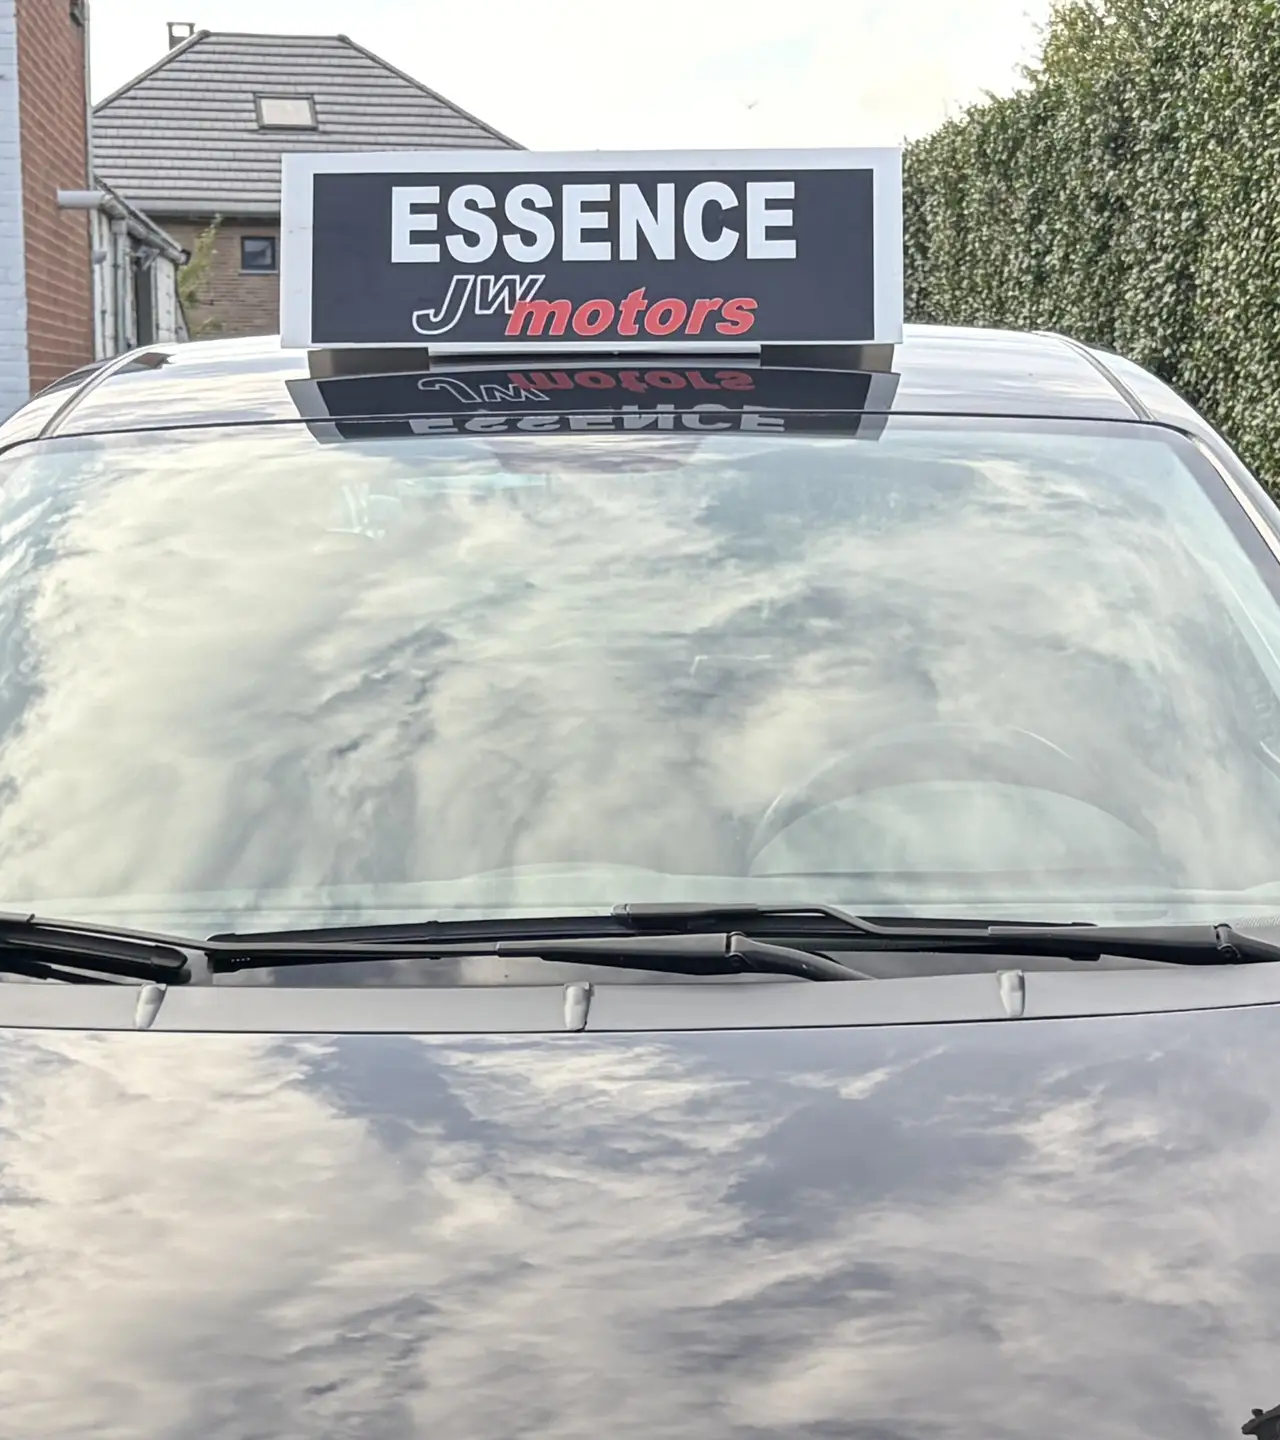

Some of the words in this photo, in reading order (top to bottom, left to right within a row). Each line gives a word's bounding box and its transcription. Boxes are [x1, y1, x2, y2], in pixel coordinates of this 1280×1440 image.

[391, 181, 797, 263] ESSENCE
[412, 274, 546, 335] JW
[504, 287, 759, 336] motors
